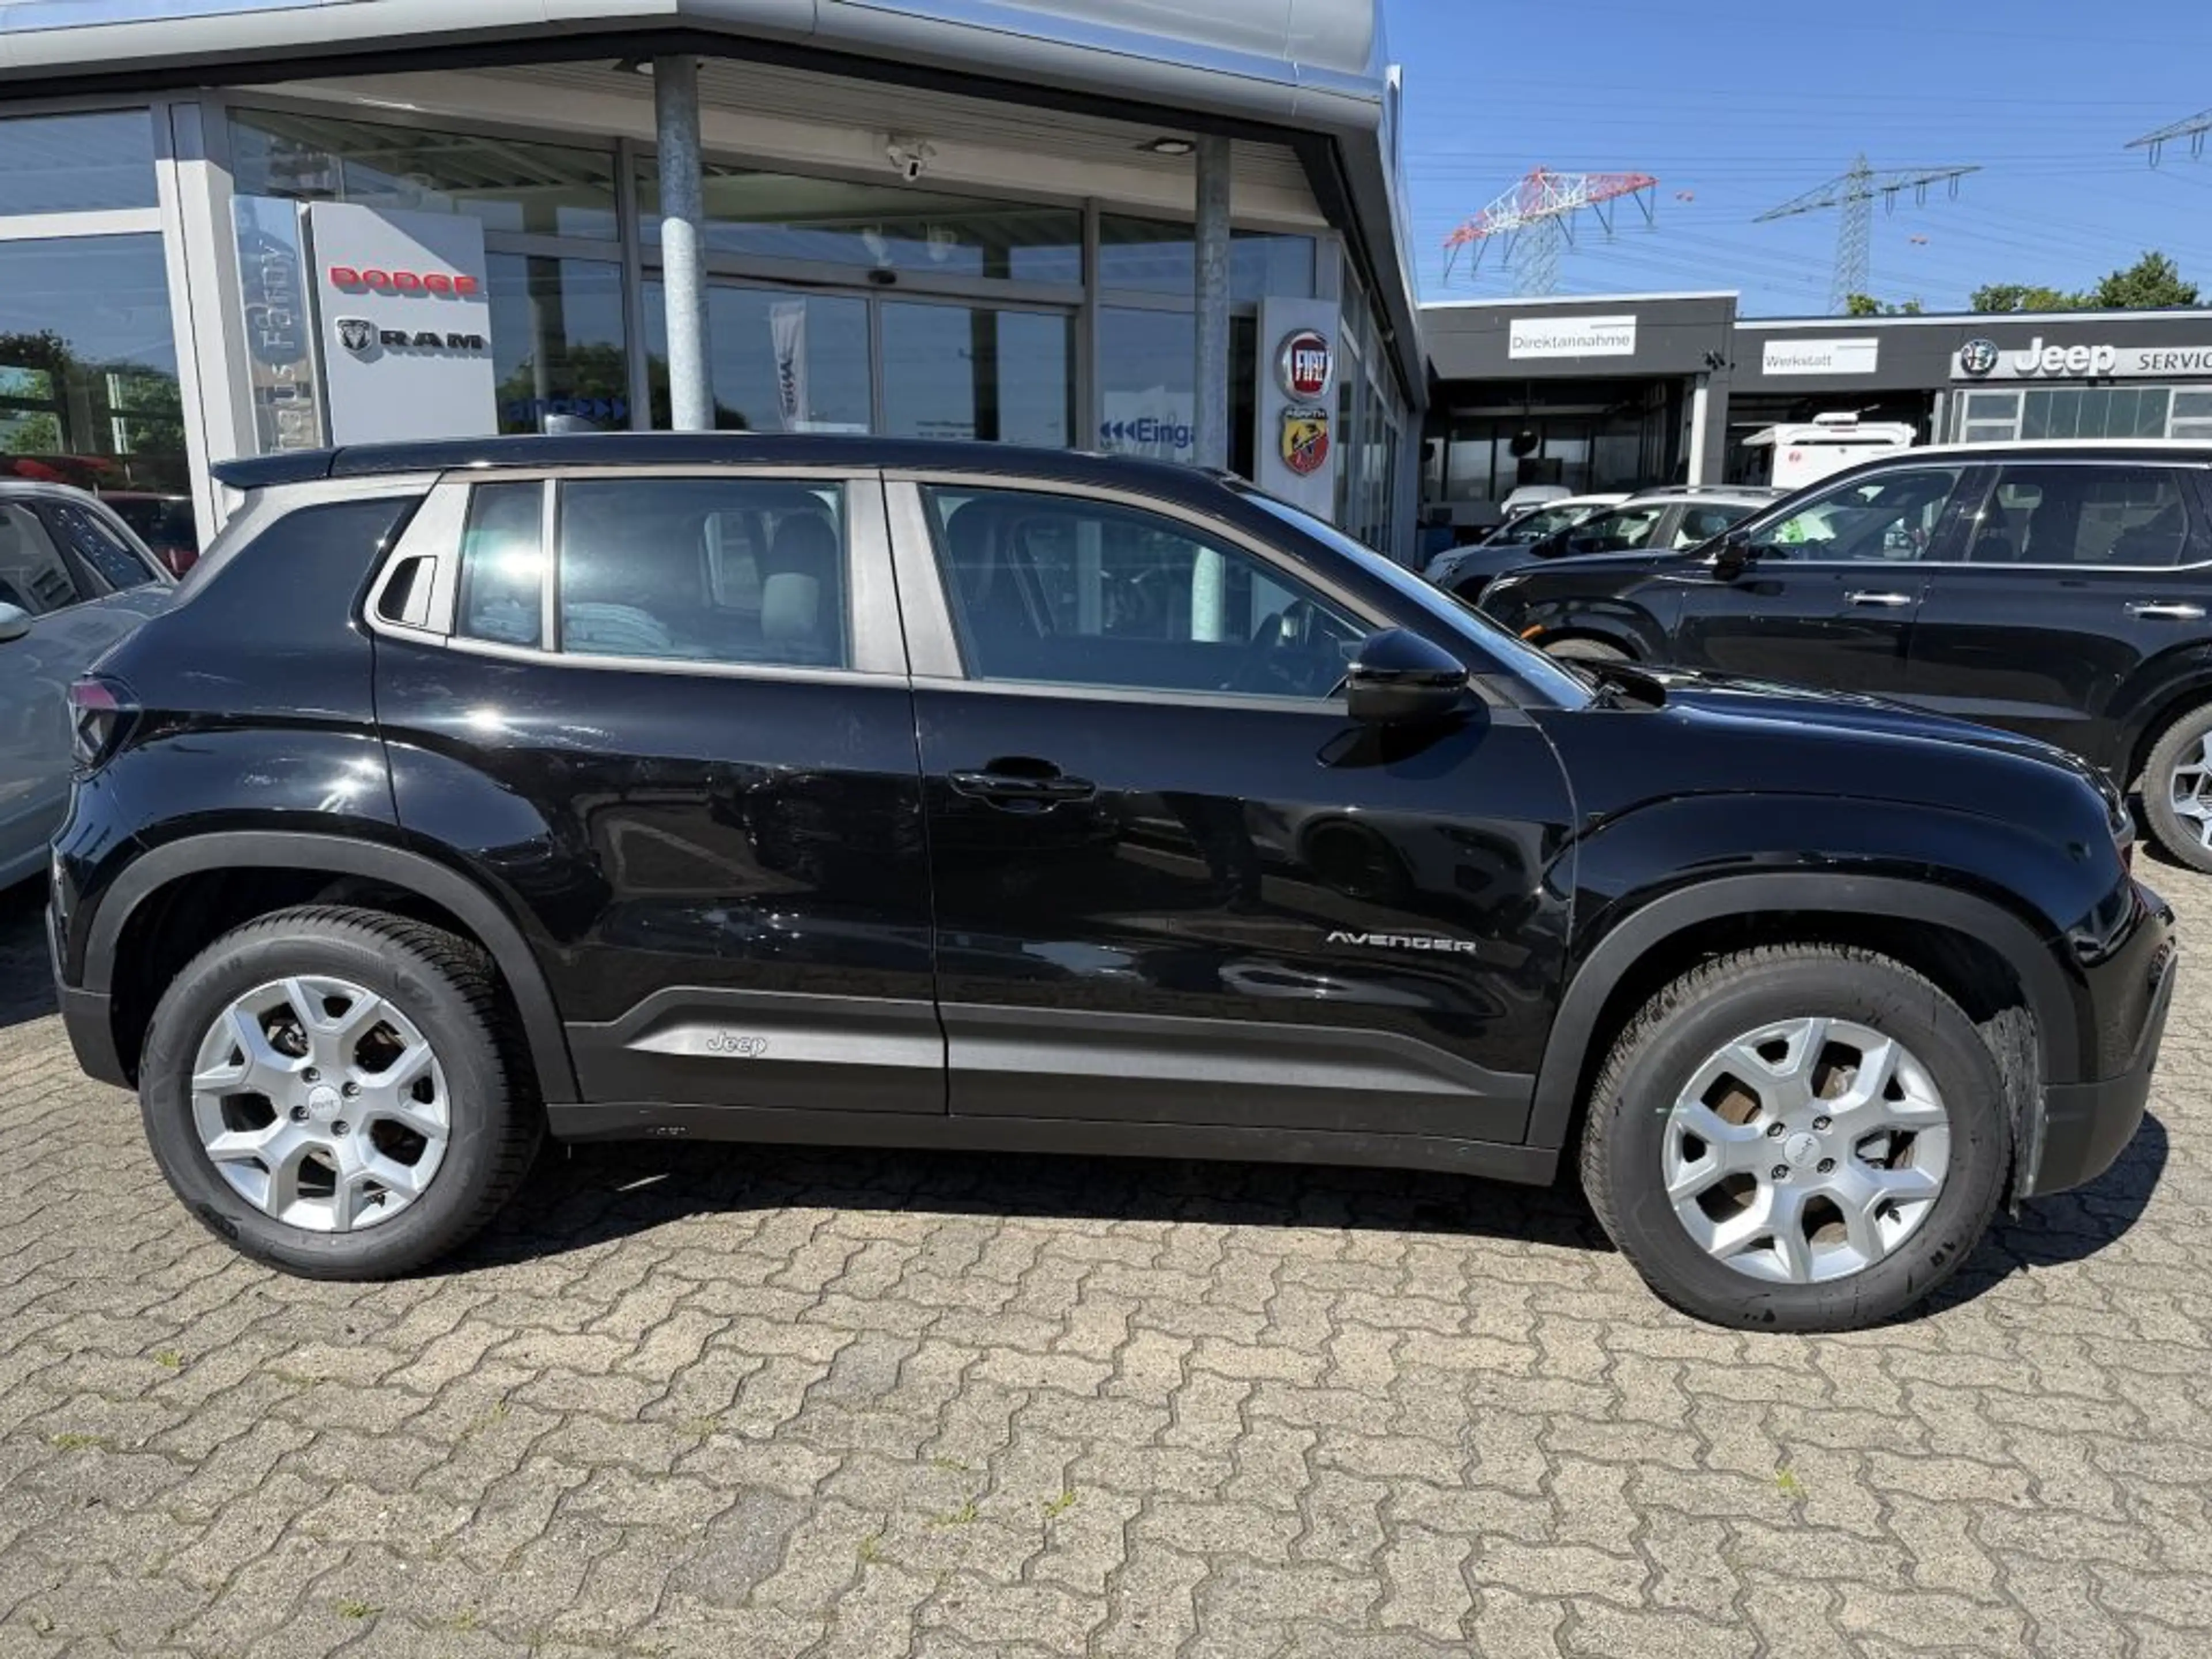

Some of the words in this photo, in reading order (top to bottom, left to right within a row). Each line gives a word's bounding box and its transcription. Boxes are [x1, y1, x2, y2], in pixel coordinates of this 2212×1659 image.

[331, 267, 478, 296] DODGE
[380, 330, 483, 350] RAM
[1512, 334, 1630, 349] Direktannahme
[1296, 350, 1326, 381] FIAT
[1766, 355, 1832, 368] Werkstatt
[2014, 337, 2116, 376] Jeep
[1326, 931, 1476, 953] AVENGER
[706, 1031, 767, 1058] Jeep
